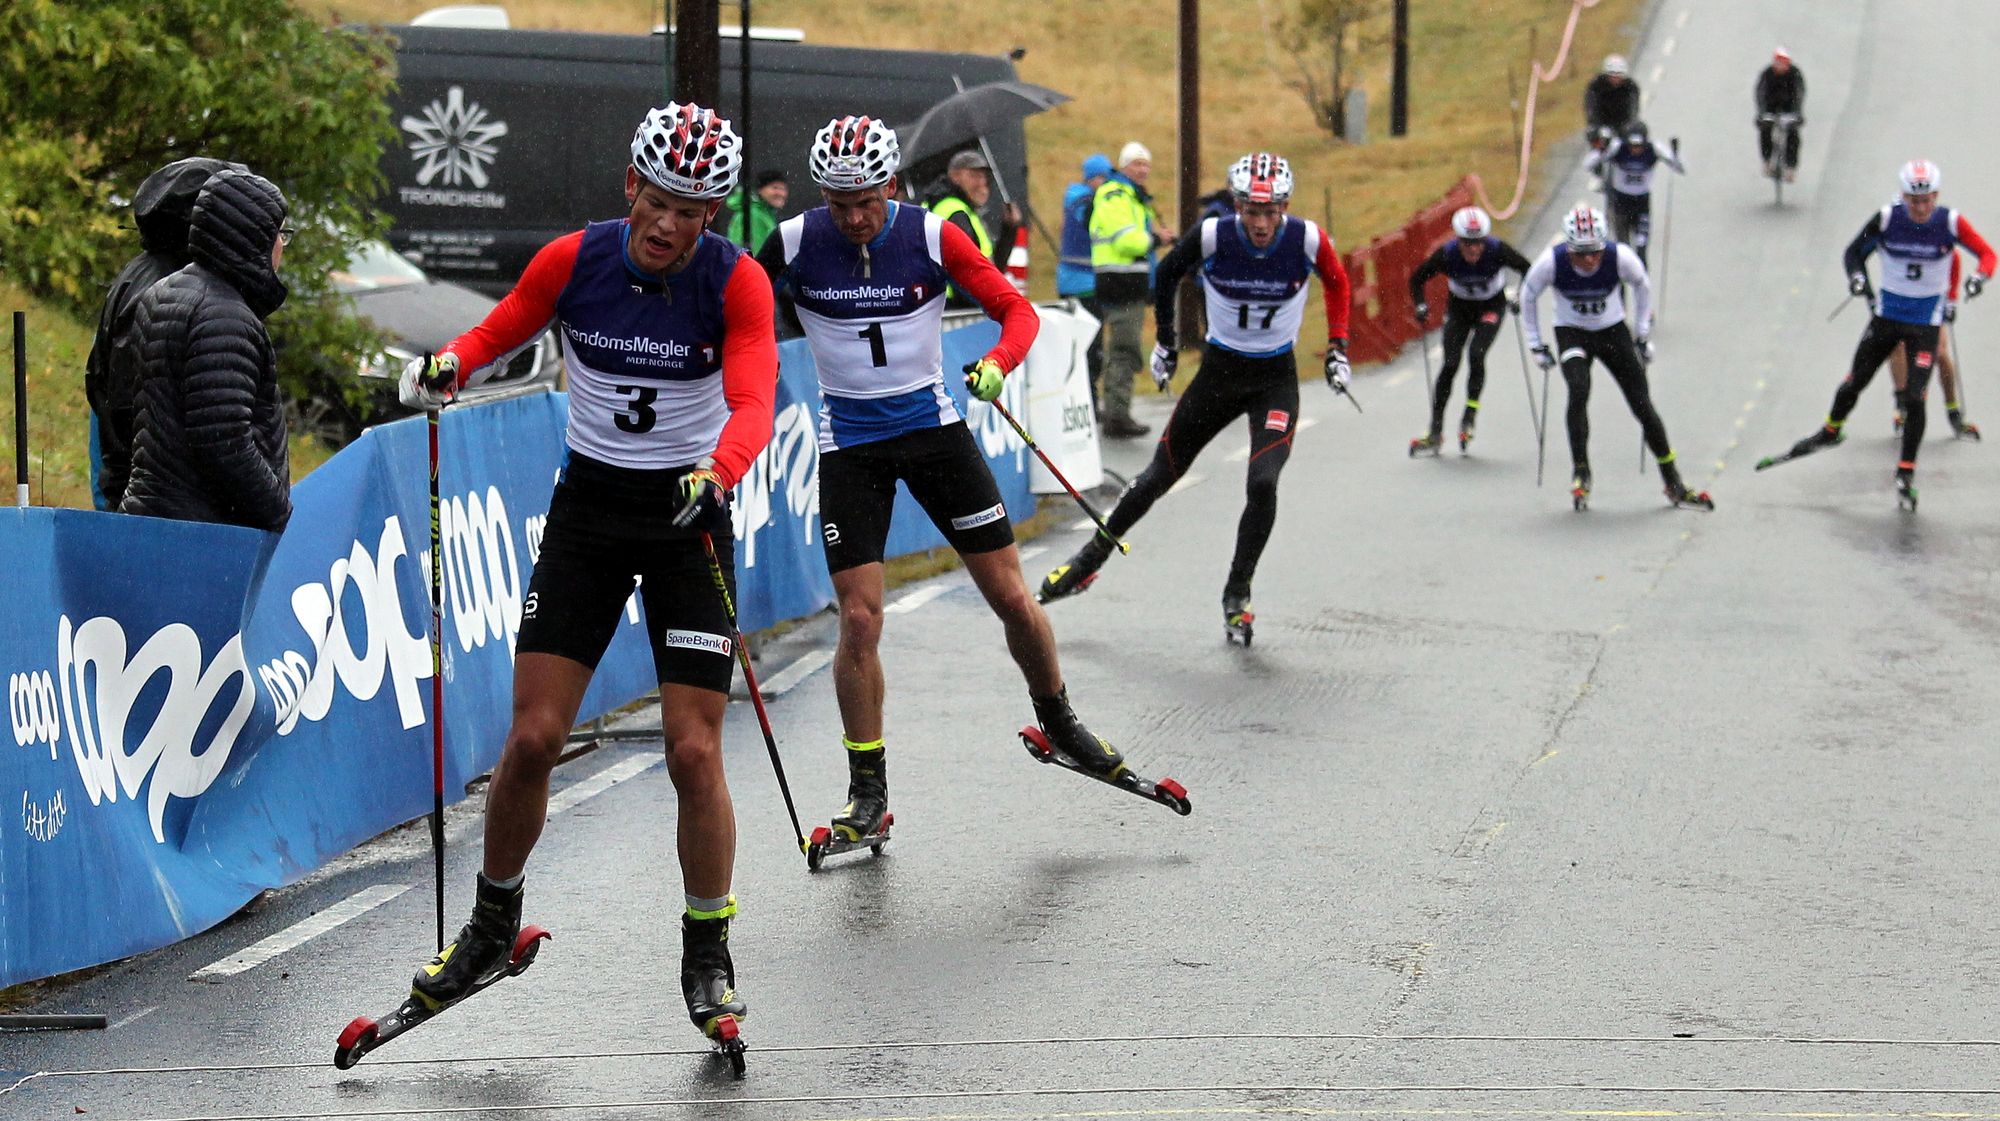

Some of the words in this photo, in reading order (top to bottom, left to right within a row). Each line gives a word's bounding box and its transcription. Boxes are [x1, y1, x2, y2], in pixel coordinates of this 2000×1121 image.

[399, 186, 506, 209] TRONDHEIM
[1239, 303, 1281, 330] 17
[857, 322, 887, 368] 1
[614, 385, 658, 433] 3
[668, 633, 721, 649] SpareBank
[10, 669, 60, 761] coop
[57, 614, 256, 844] coop
